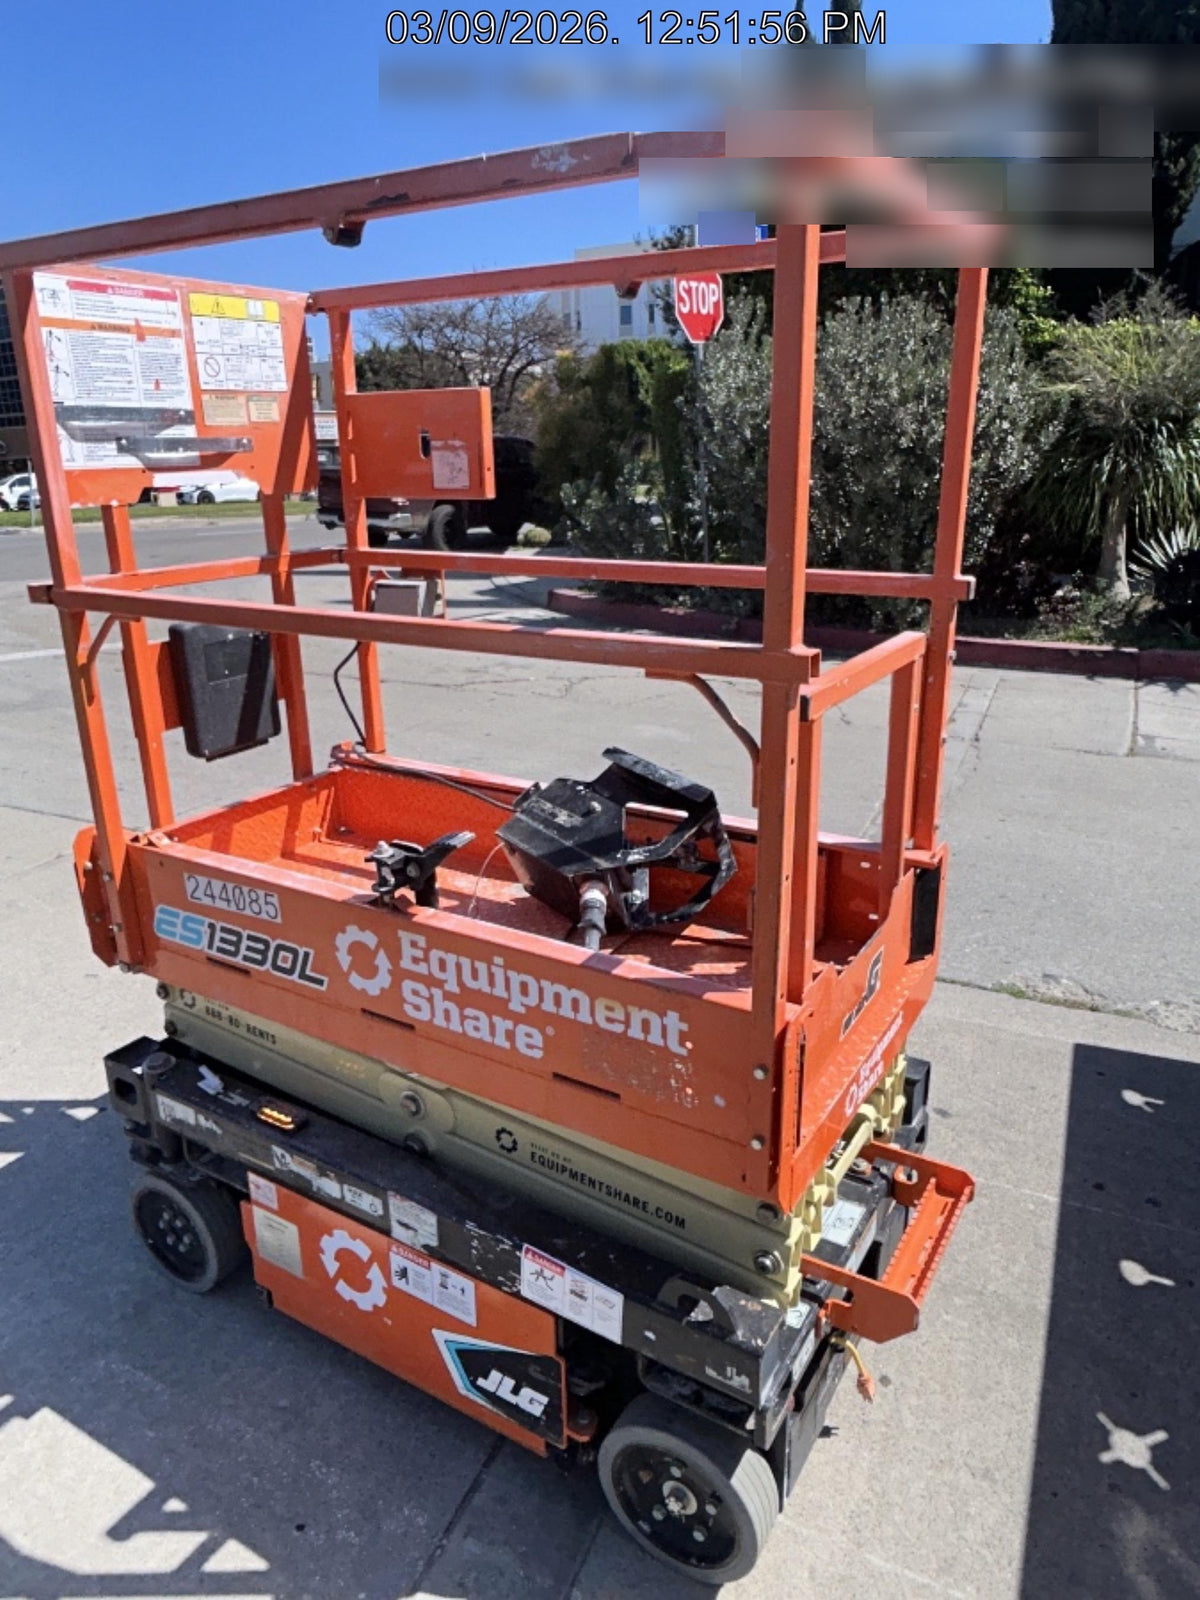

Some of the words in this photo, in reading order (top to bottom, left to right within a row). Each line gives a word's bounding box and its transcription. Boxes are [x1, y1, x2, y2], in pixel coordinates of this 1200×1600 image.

[679, 280, 719, 315] STOP
[187, 875, 279, 920] 244085
[154, 905, 327, 990] ES1330L
[397, 929, 689, 1057] Equipment
[401, 978, 545, 1060] Share
[530, 1151, 686, 1230] EQUIPMENTSHARE.COM
[476, 1369, 550, 1418] JLG
